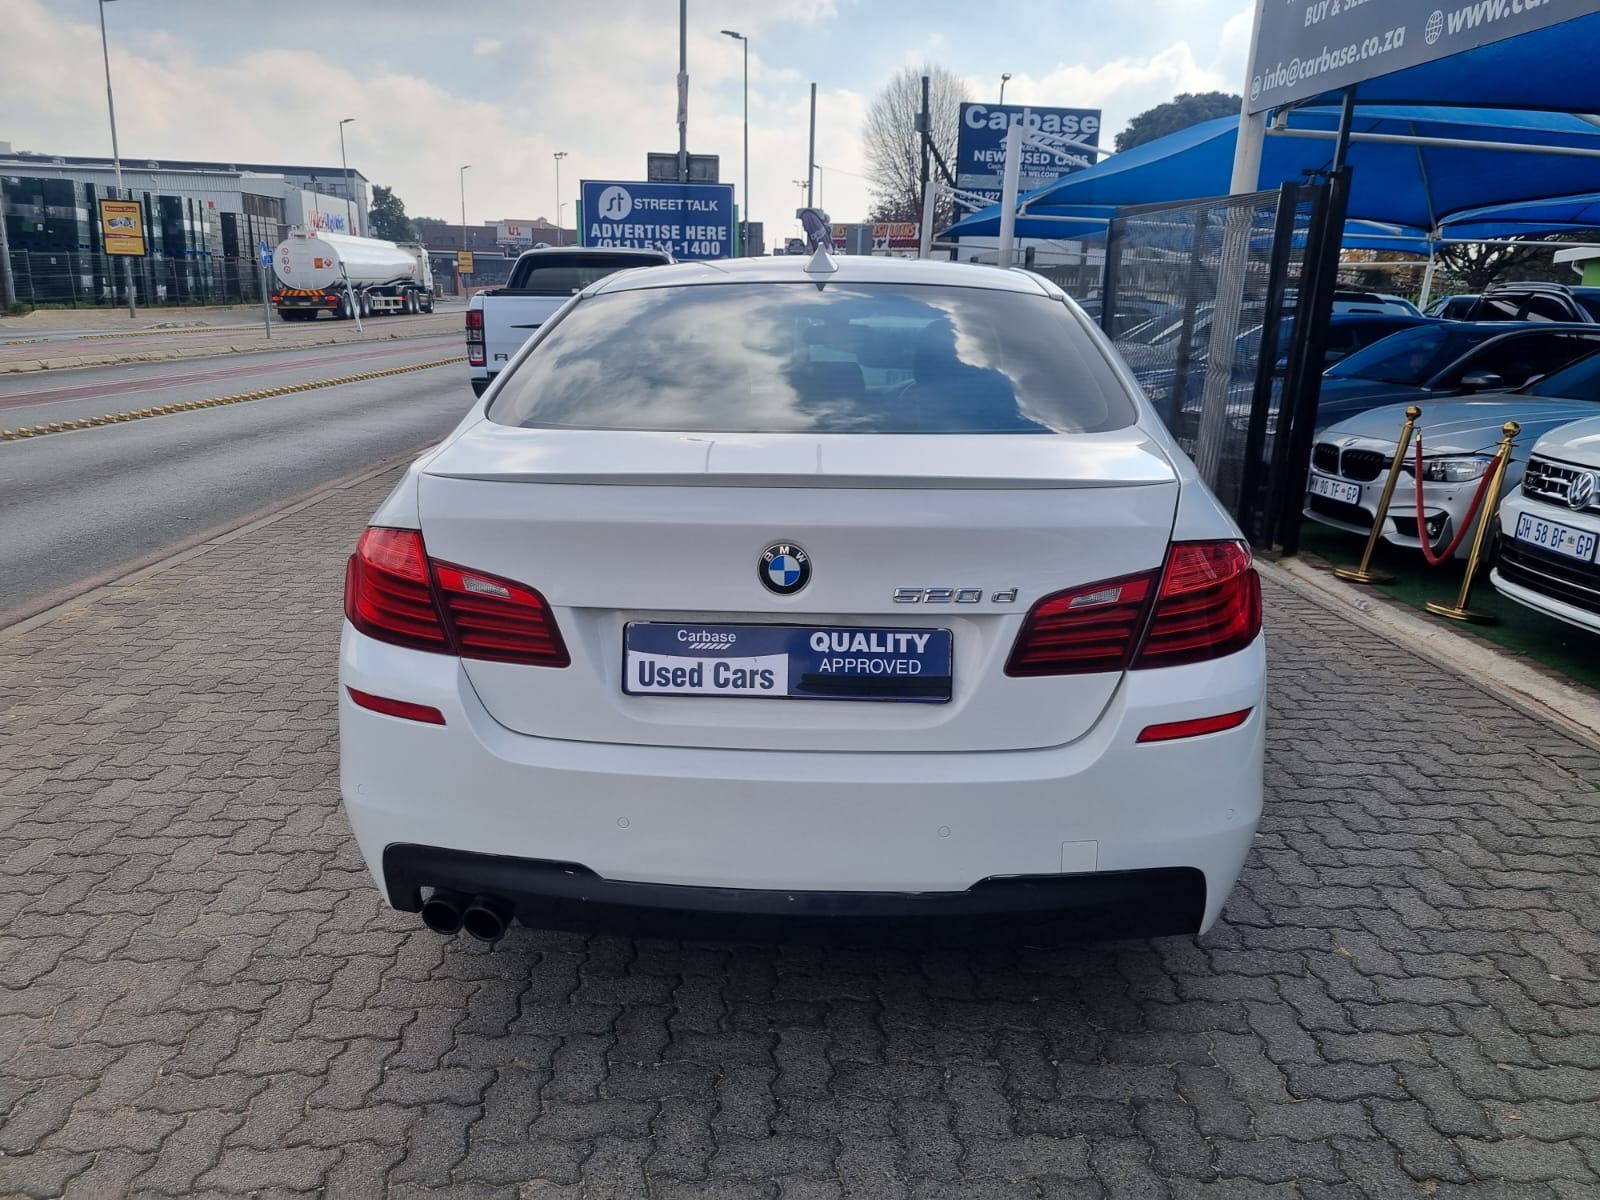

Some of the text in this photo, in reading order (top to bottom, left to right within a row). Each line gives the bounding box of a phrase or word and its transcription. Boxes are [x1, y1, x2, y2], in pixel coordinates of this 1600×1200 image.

[1304, 0, 1329, 27] BUY
[1263, 26, 1406, 92] info@carbase.co.za
[965, 105, 1099, 134] Carbase
[973, 150, 1006, 163] NEW
[1029, 170, 1060, 178] WELCOME
[634, 198, 718, 211] STREET TALK
[591, 223, 727, 241] ADVERTISE HERE
[597, 238, 639, 248] (011)
[1346, 486, 1357, 502] GP
[1518, 517, 1593, 557] JH 58 BF GP
[764, 546, 806, 562] BMW
[893, 587, 1018, 604] 520 d
[677, 629, 737, 643] Carbase
[809, 631, 931, 653] QUALITY
[819, 658, 922, 674] APPROVED
[638, 660, 775, 690] Used Cars
